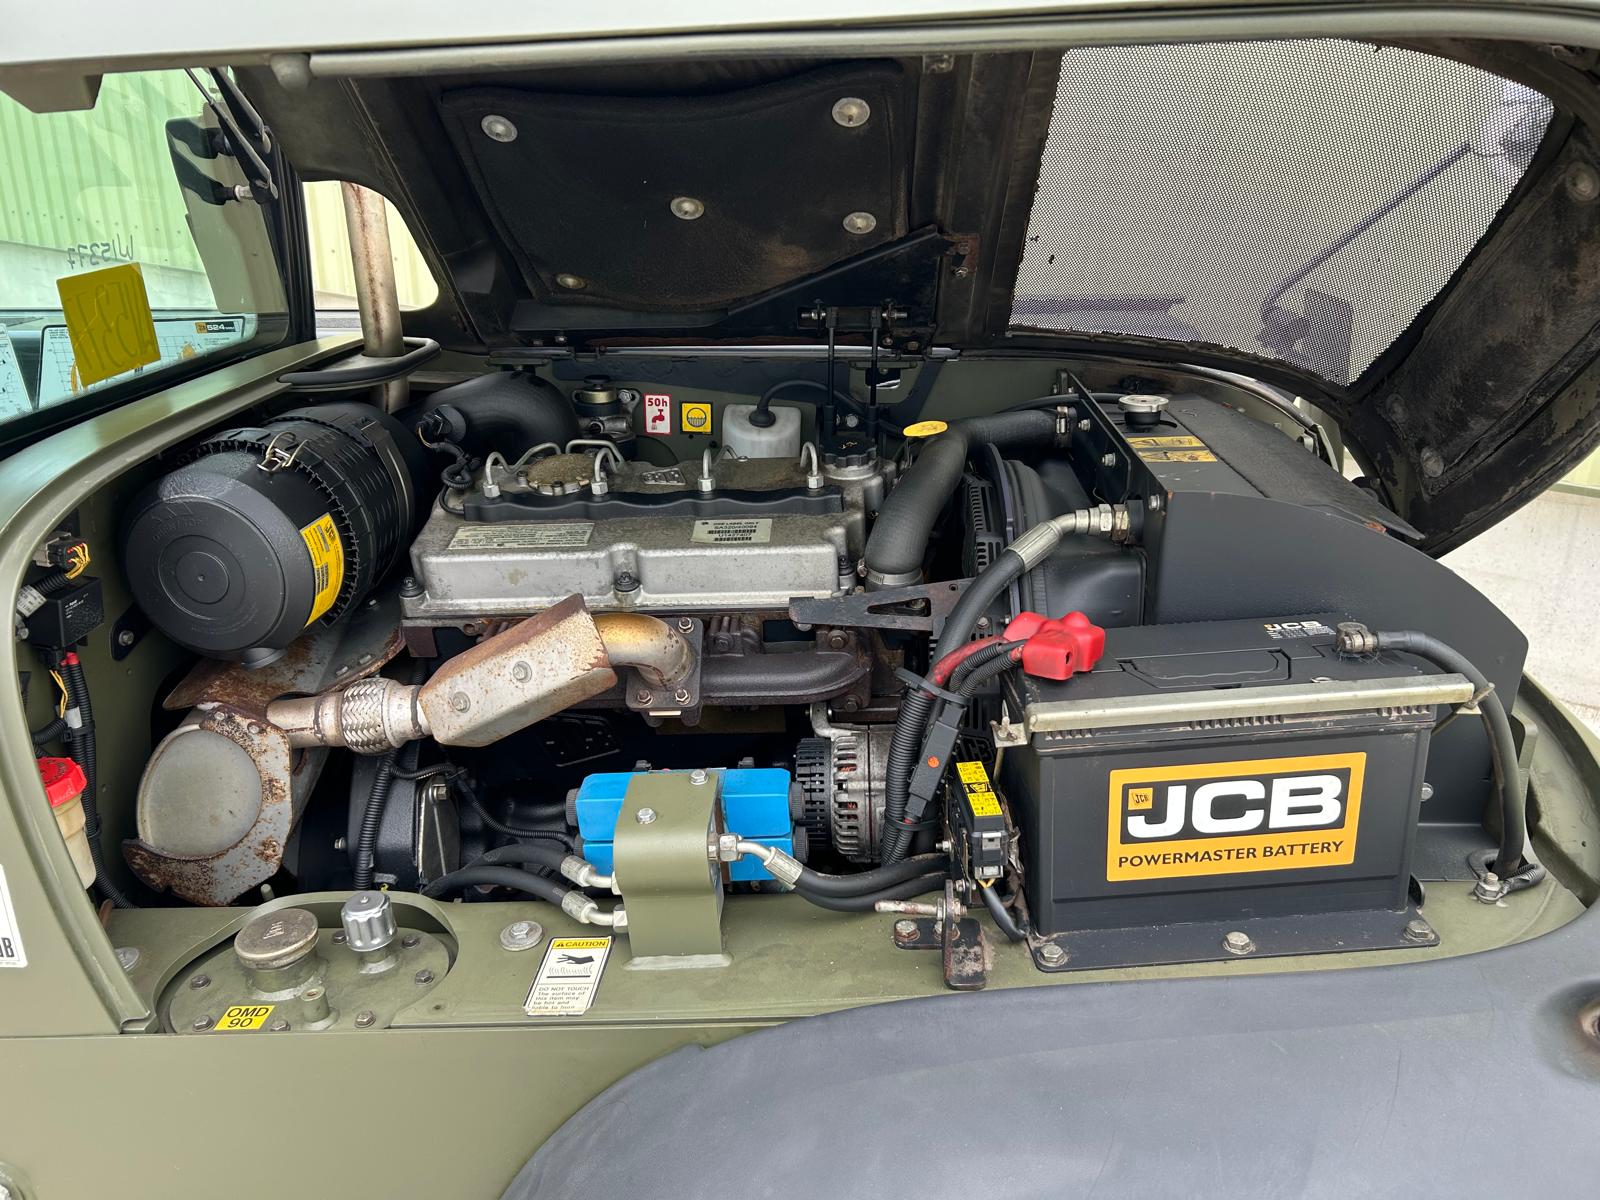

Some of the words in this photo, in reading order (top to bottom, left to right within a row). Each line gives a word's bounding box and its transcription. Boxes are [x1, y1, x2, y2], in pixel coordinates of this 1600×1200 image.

[647, 397, 668, 407] 50h
[1266, 620, 1323, 631] JCB
[1134, 792, 1149, 804] JCB
[1127, 774, 1342, 838] JCB
[1118, 846, 1257, 867] POWERMASTER
[1262, 840, 1344, 858] BATTERY
[227, 1007, 270, 1018] OMD
[227, 1018, 253, 1028] 90
